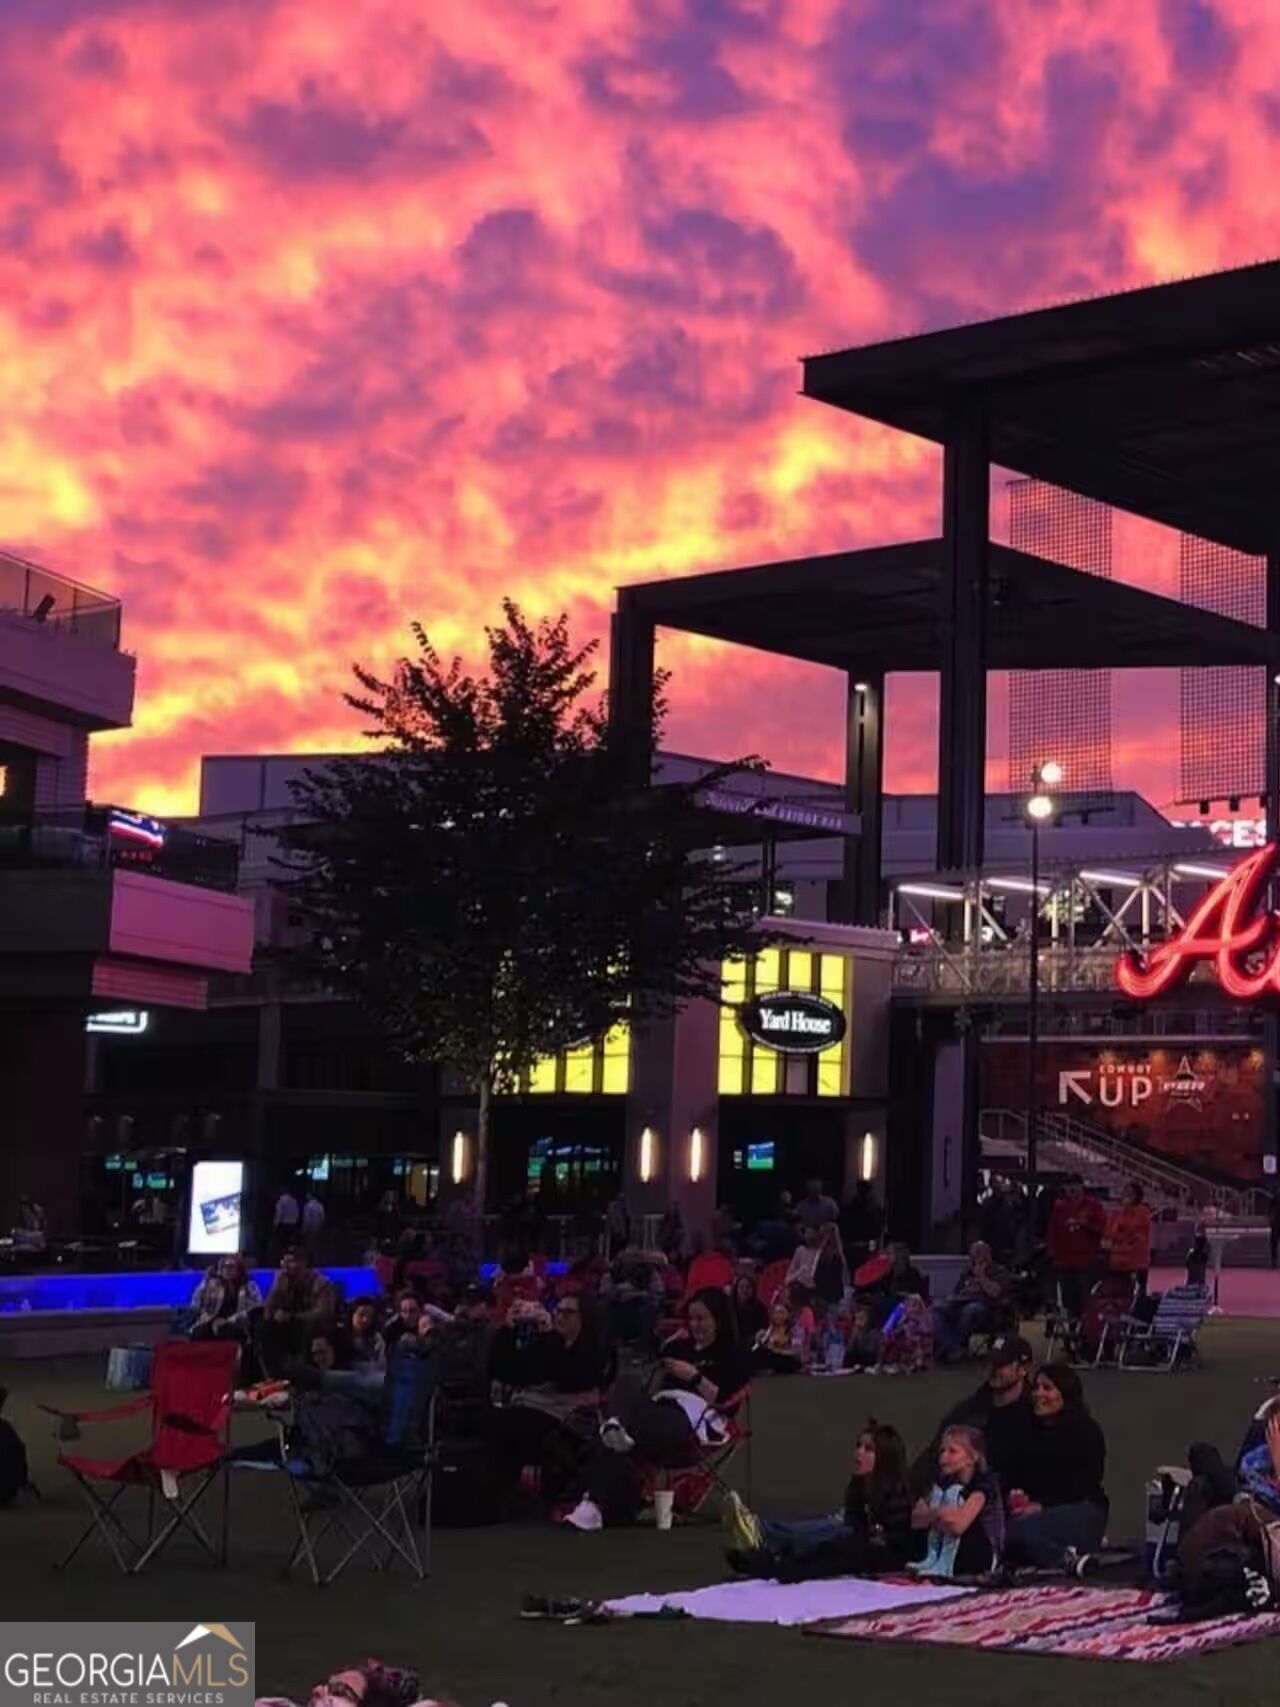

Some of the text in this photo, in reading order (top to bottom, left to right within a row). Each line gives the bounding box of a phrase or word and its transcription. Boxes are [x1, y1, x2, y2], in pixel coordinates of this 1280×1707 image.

[759, 1009, 832, 1034] Yard House
[1099, 1064, 1152, 1074] COWBOY
[1099, 1075, 1153, 1107] UP
